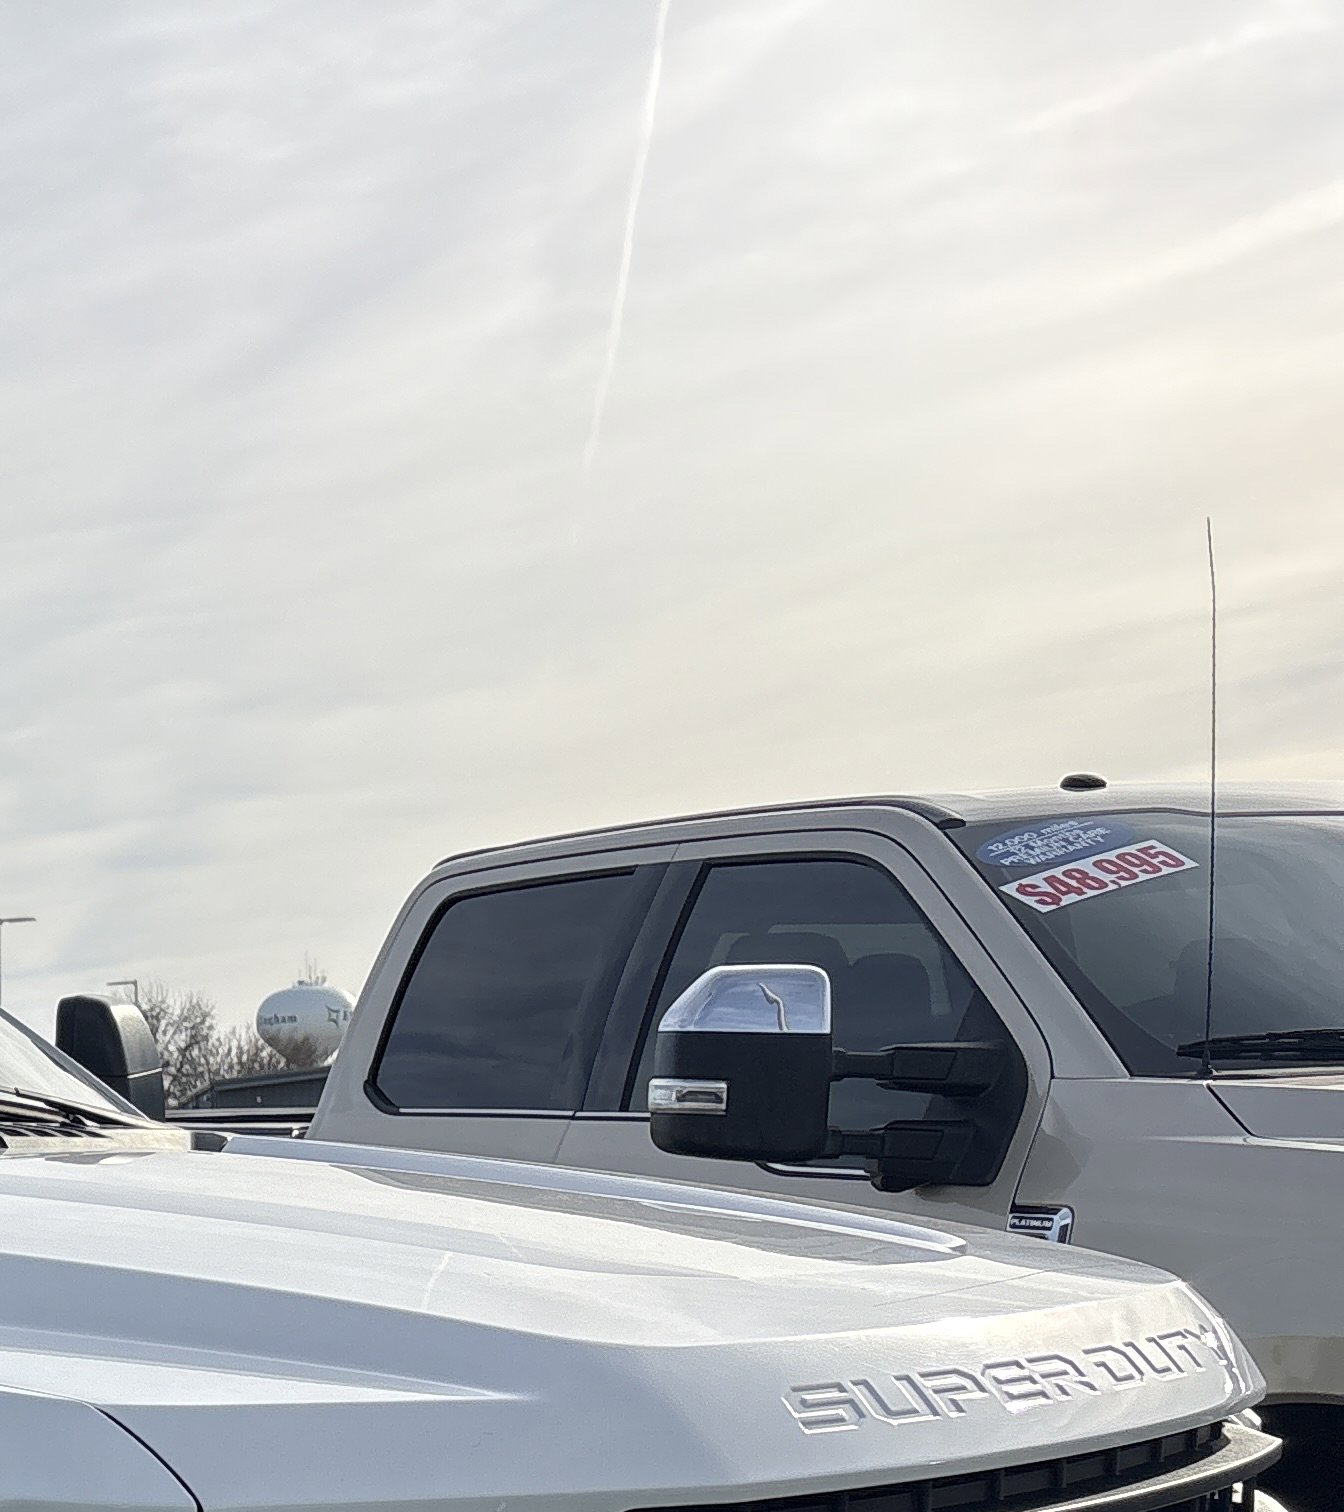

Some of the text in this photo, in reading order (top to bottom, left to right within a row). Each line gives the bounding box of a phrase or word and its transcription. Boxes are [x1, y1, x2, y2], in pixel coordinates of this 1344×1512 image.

[1015, 845, 1186, 907] $48,995
[782, 1323, 1229, 1434] SUPER DUTY
